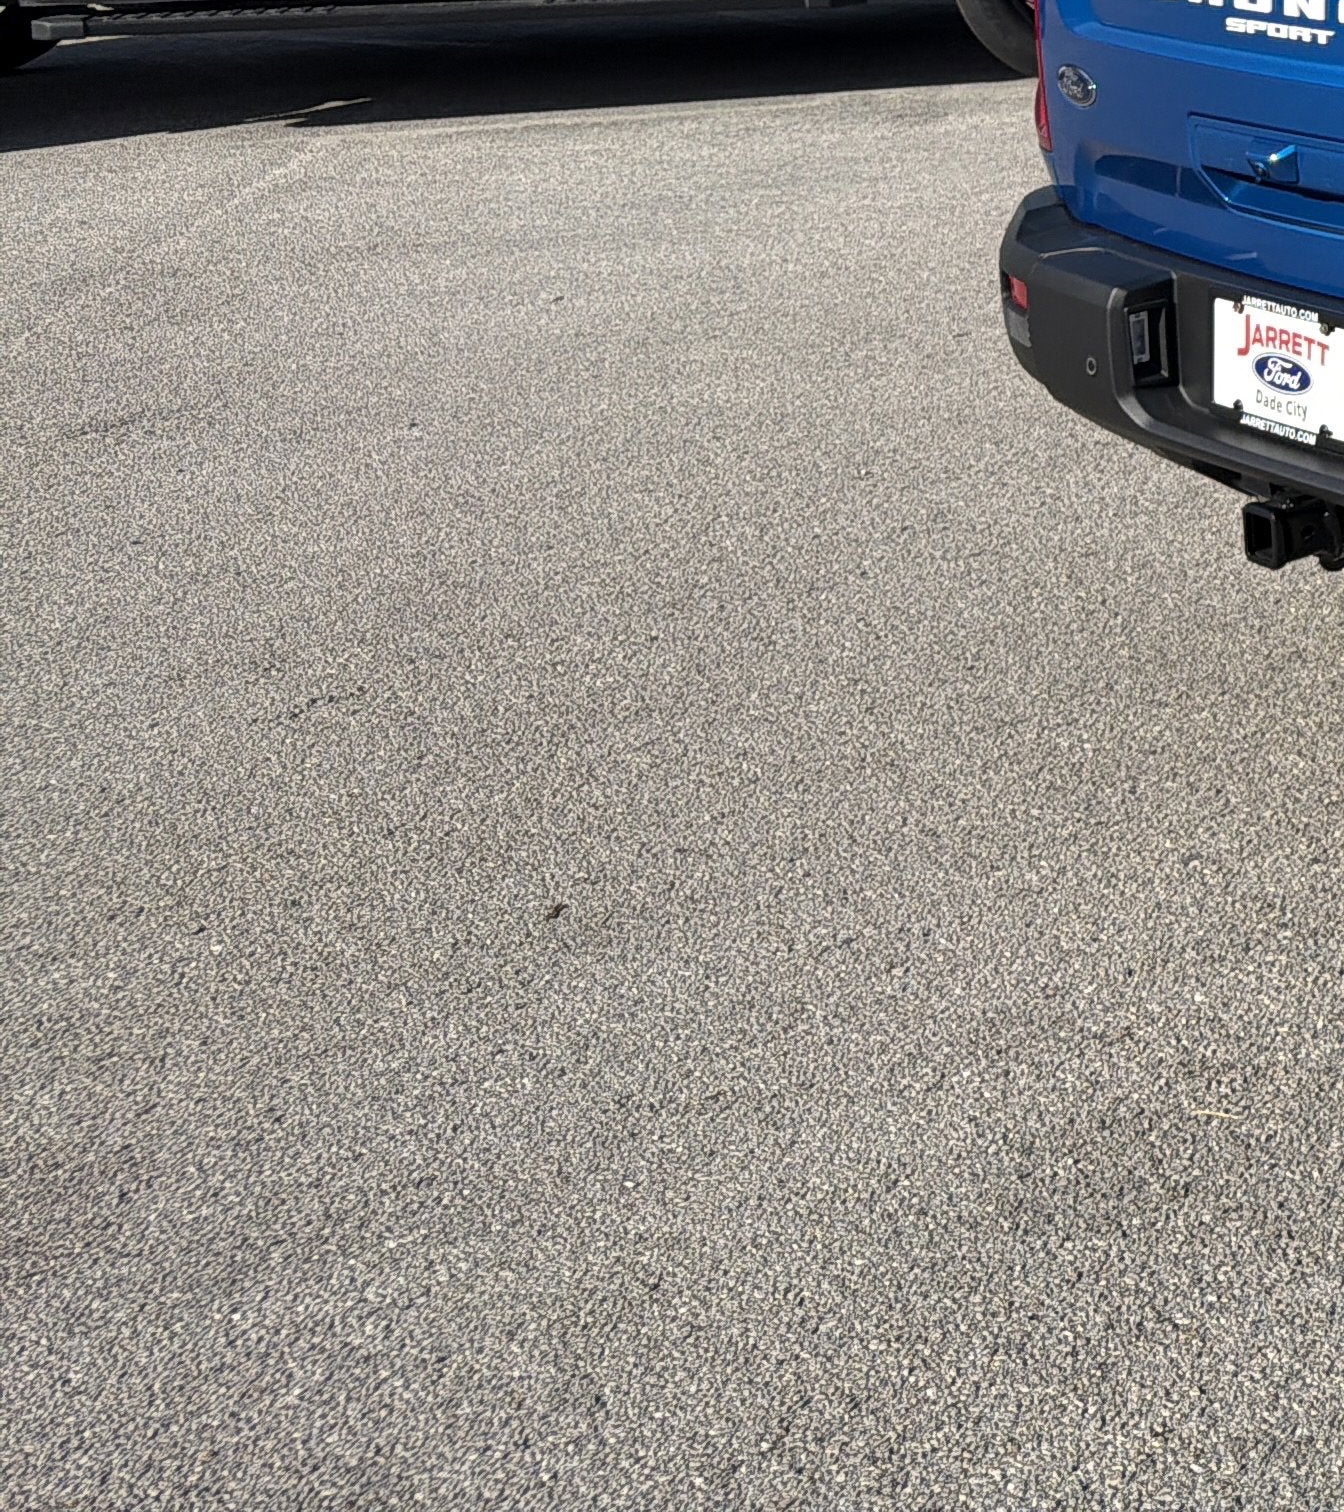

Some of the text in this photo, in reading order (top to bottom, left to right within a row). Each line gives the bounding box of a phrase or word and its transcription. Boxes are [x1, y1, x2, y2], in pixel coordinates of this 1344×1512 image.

[1225, 17, 1336, 45] SPORT
[1242, 295, 1319, 322] JARRETTAUTO.COM
[1237, 313, 1330, 366] JARRETT
[1263, 357, 1302, 390] Ford
[1256, 389, 1308, 422] Dade City
[1240, 413, 1317, 446] JARRETTAUTO.COM
